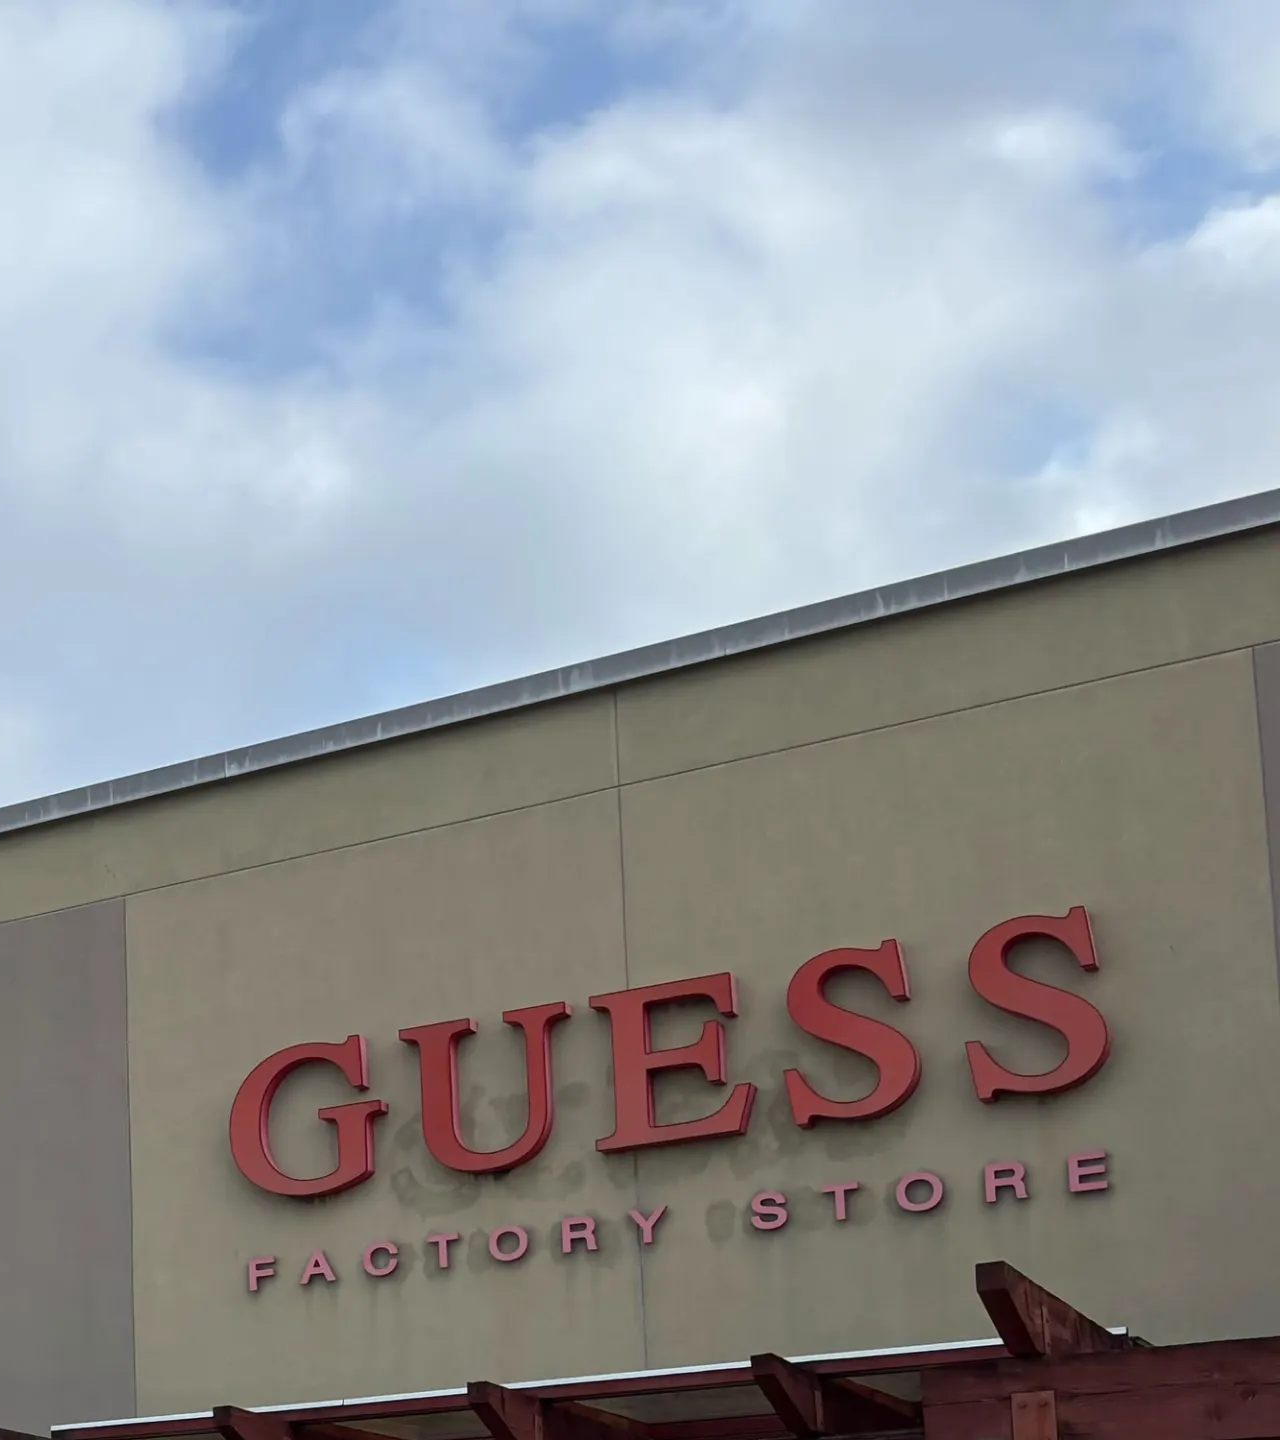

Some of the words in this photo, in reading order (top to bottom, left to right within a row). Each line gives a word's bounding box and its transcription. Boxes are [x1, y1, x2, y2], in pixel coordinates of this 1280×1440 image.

[229, 905, 1111, 1197] GUESS
[247, 1204, 669, 1292] FACTORY
[749, 1149, 1110, 1231] STORE
